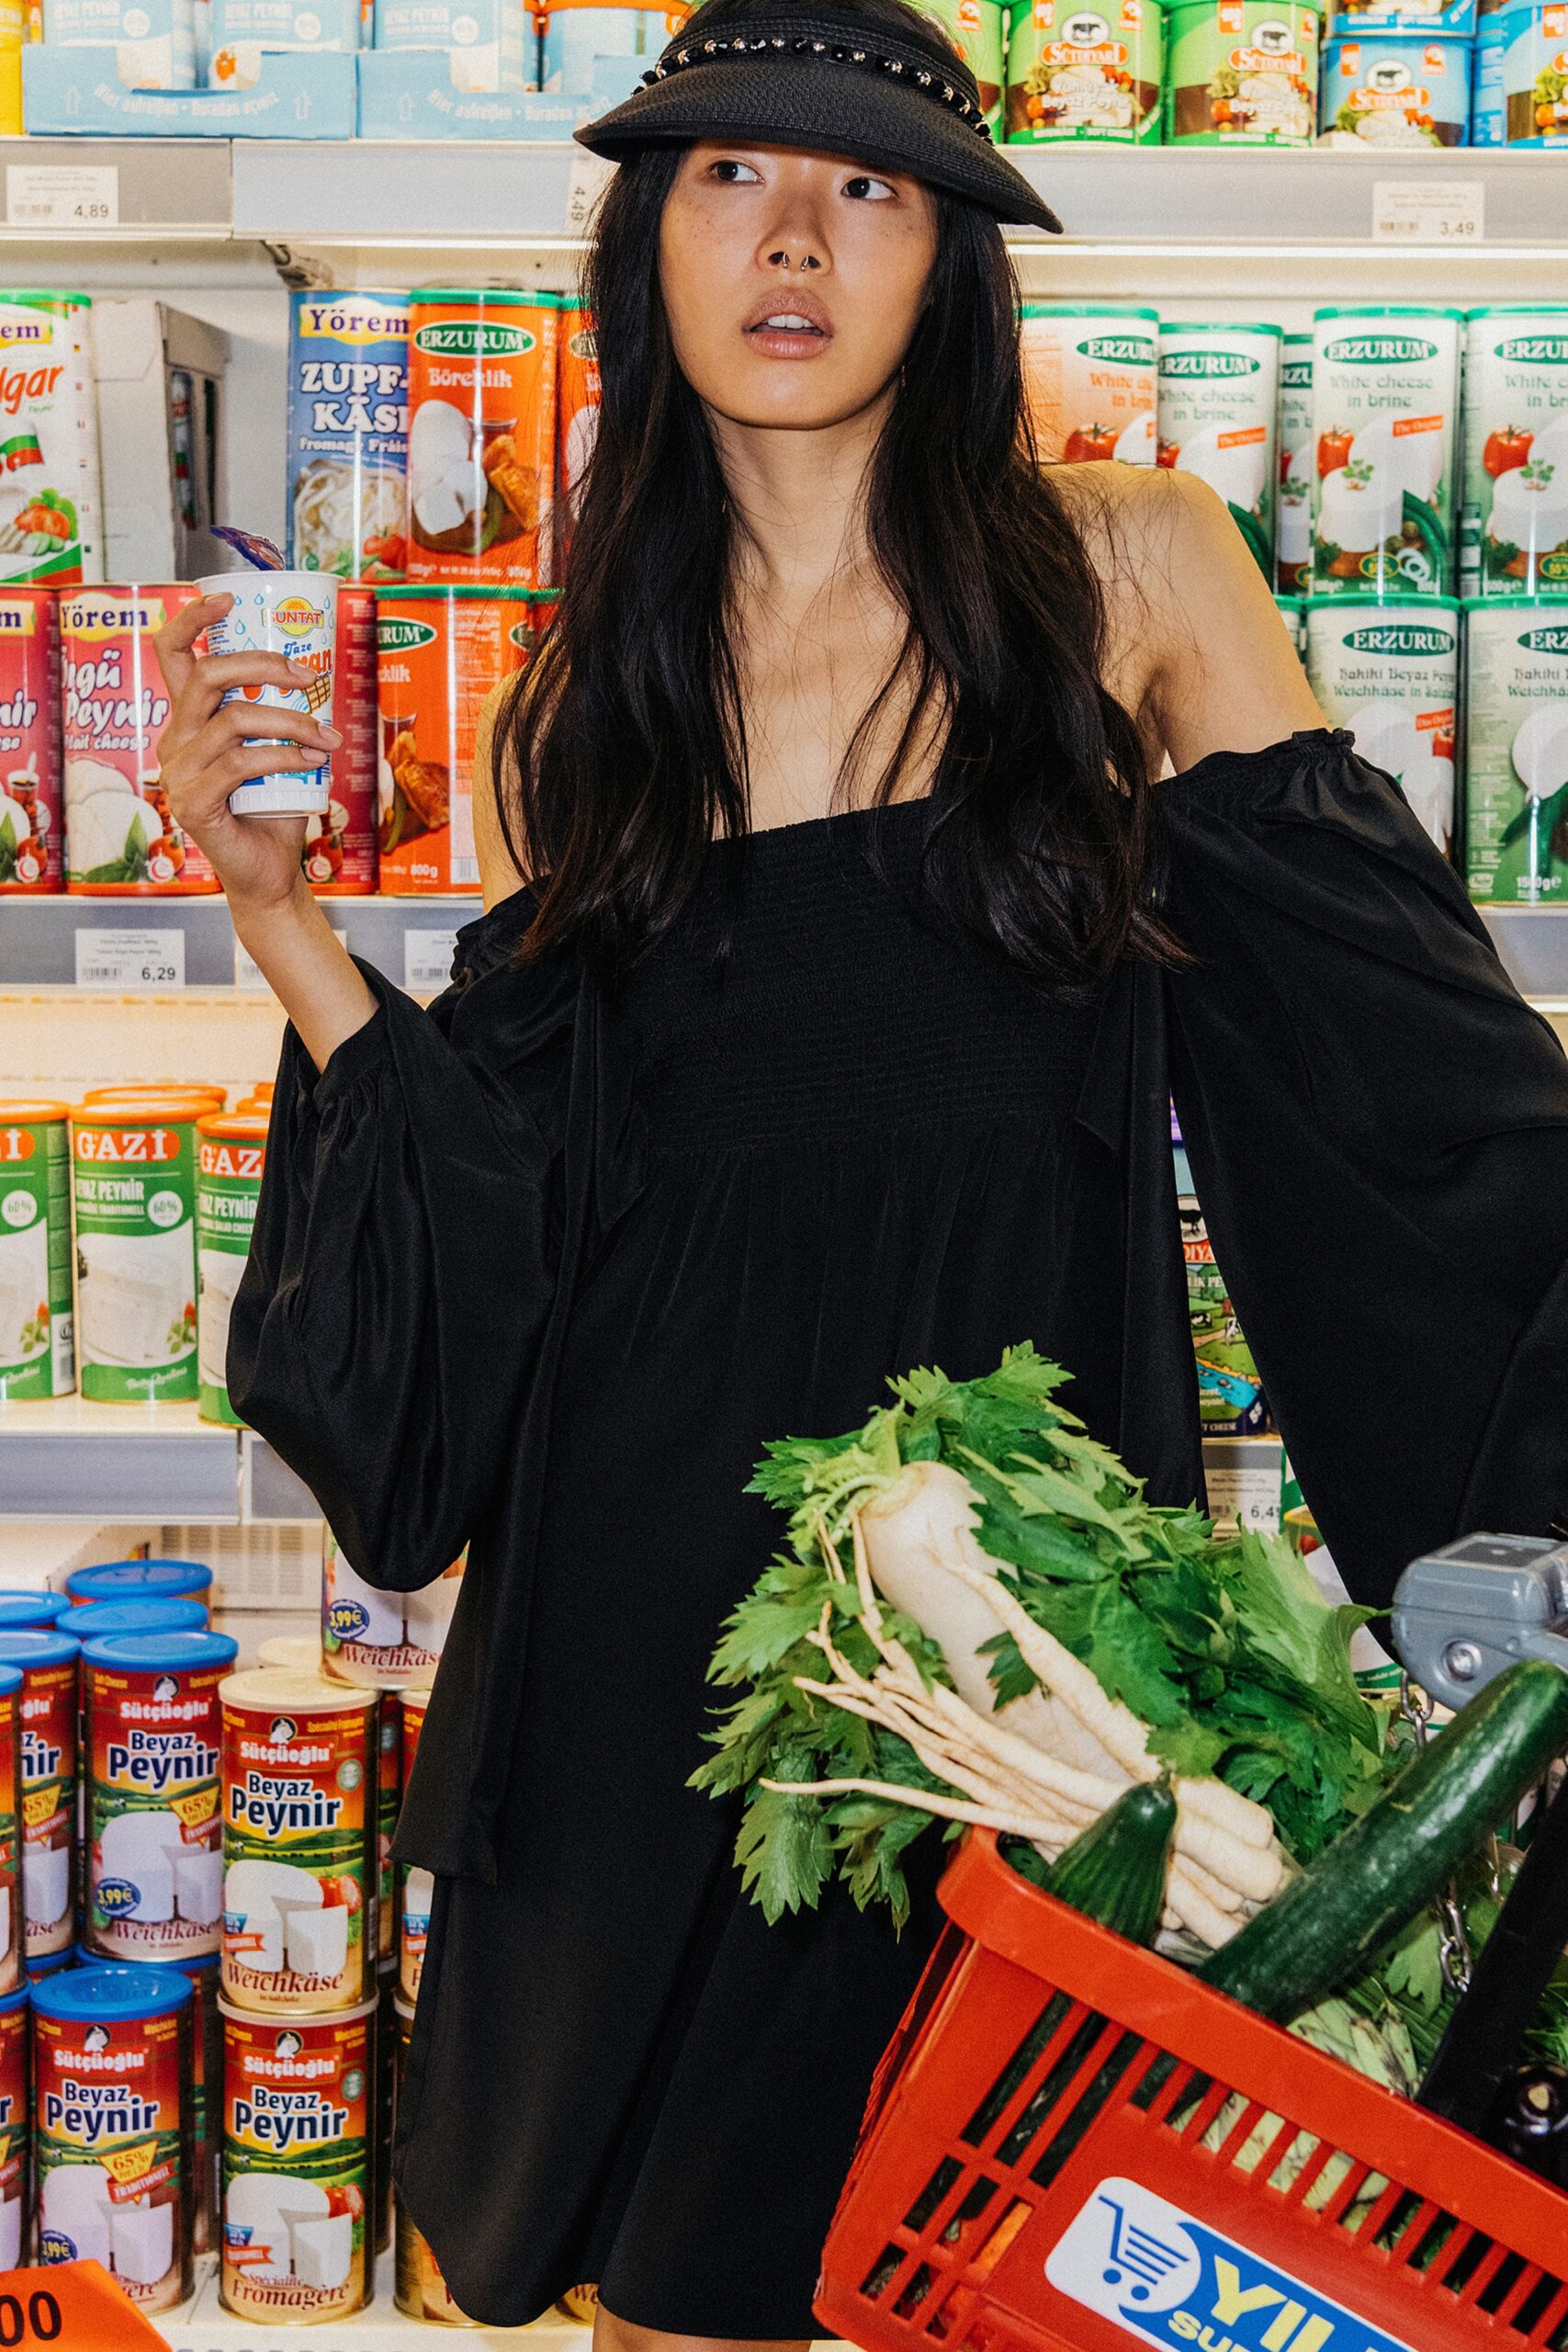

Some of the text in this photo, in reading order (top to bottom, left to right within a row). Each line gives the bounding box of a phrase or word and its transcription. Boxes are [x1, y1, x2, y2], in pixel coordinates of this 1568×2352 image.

[74, 204, 108, 220] 4,89
[1438, 221, 1475, 236] 3,49
[420, 329, 522, 351] ERZURUM
[1328, 340, 1430, 359] ERZURUM
[428, 368, 513, 389] Böreklik
[1377, 375, 1433, 390] cheese
[1505, 374, 1551, 389] White
[1348, 393, 1412, 408] in brine
[62, 605, 149, 628] Yörem
[268, 611, 321, 626] SUNTAT
[283, 641, 312, 658] Taze
[1352, 631, 1450, 651] ERZURUM
[64, 689, 169, 736] Peynir
[94, 732, 151, 752] cheese
[141, 967, 176, 982] 6,29
[76, 1129, 168, 1160] GAZİ
[97, 1177, 145, 1201] PEYNİR
[7, 1201, 32, 1214] 60%
[152, 1201, 177, 1214] 60%
[119, 1700, 209, 1723] Sütçüoğlu
[131, 1731, 194, 1755] Beyaz
[240, 1741, 330, 1766] Sütçüoğlu
[109, 1744, 219, 1790] Peynir
[249, 1773, 310, 1801] Beyaz
[231, 1792, 341, 1836] Peynir
[116, 1921, 213, 1941] Weichkäse
[228, 1962, 344, 1994] Weichkäse
[53, 2049, 145, 2073] Sütçüoğlu
[243, 2054, 335, 2079] Sütçüoğlu
[65, 2081, 128, 2109] Beyaz
[254, 2088, 318, 2114] Beyaz
[47, 2098, 159, 2143] Peynir
[235, 2104, 347, 2149] Peynir
[112, 2151, 150, 2171] 65%
[1168, 2309, 1251, 2352] SU
